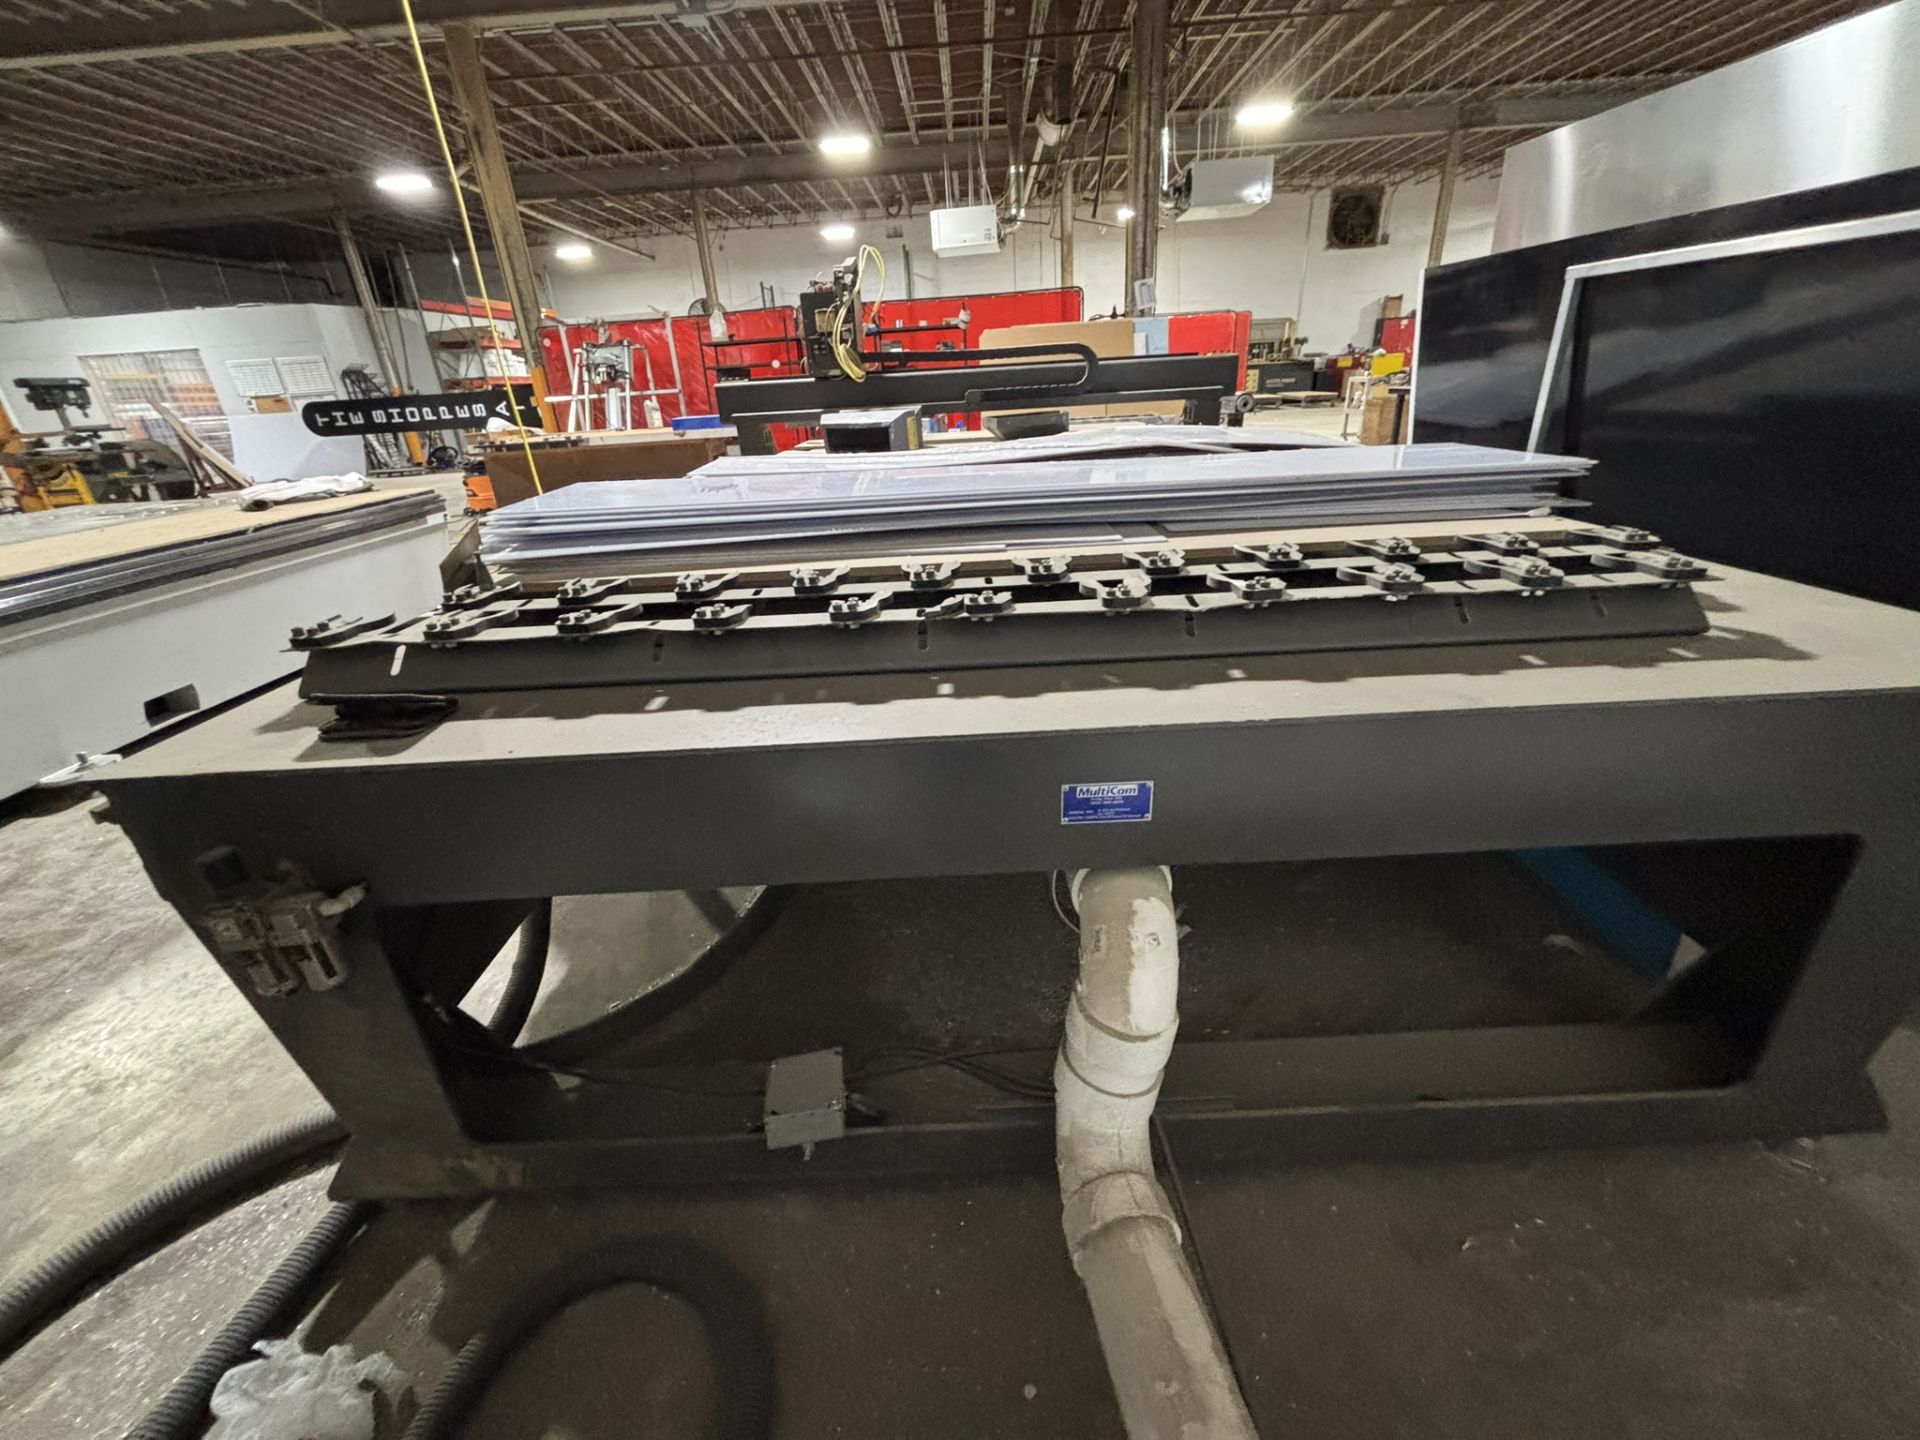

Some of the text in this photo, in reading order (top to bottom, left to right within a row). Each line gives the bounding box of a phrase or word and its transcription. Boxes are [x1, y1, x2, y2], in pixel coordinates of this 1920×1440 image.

[314, 411, 364, 427] THE
[371, 403, 487, 424] SHOPPES
[1078, 785, 1137, 797] MultiCam
